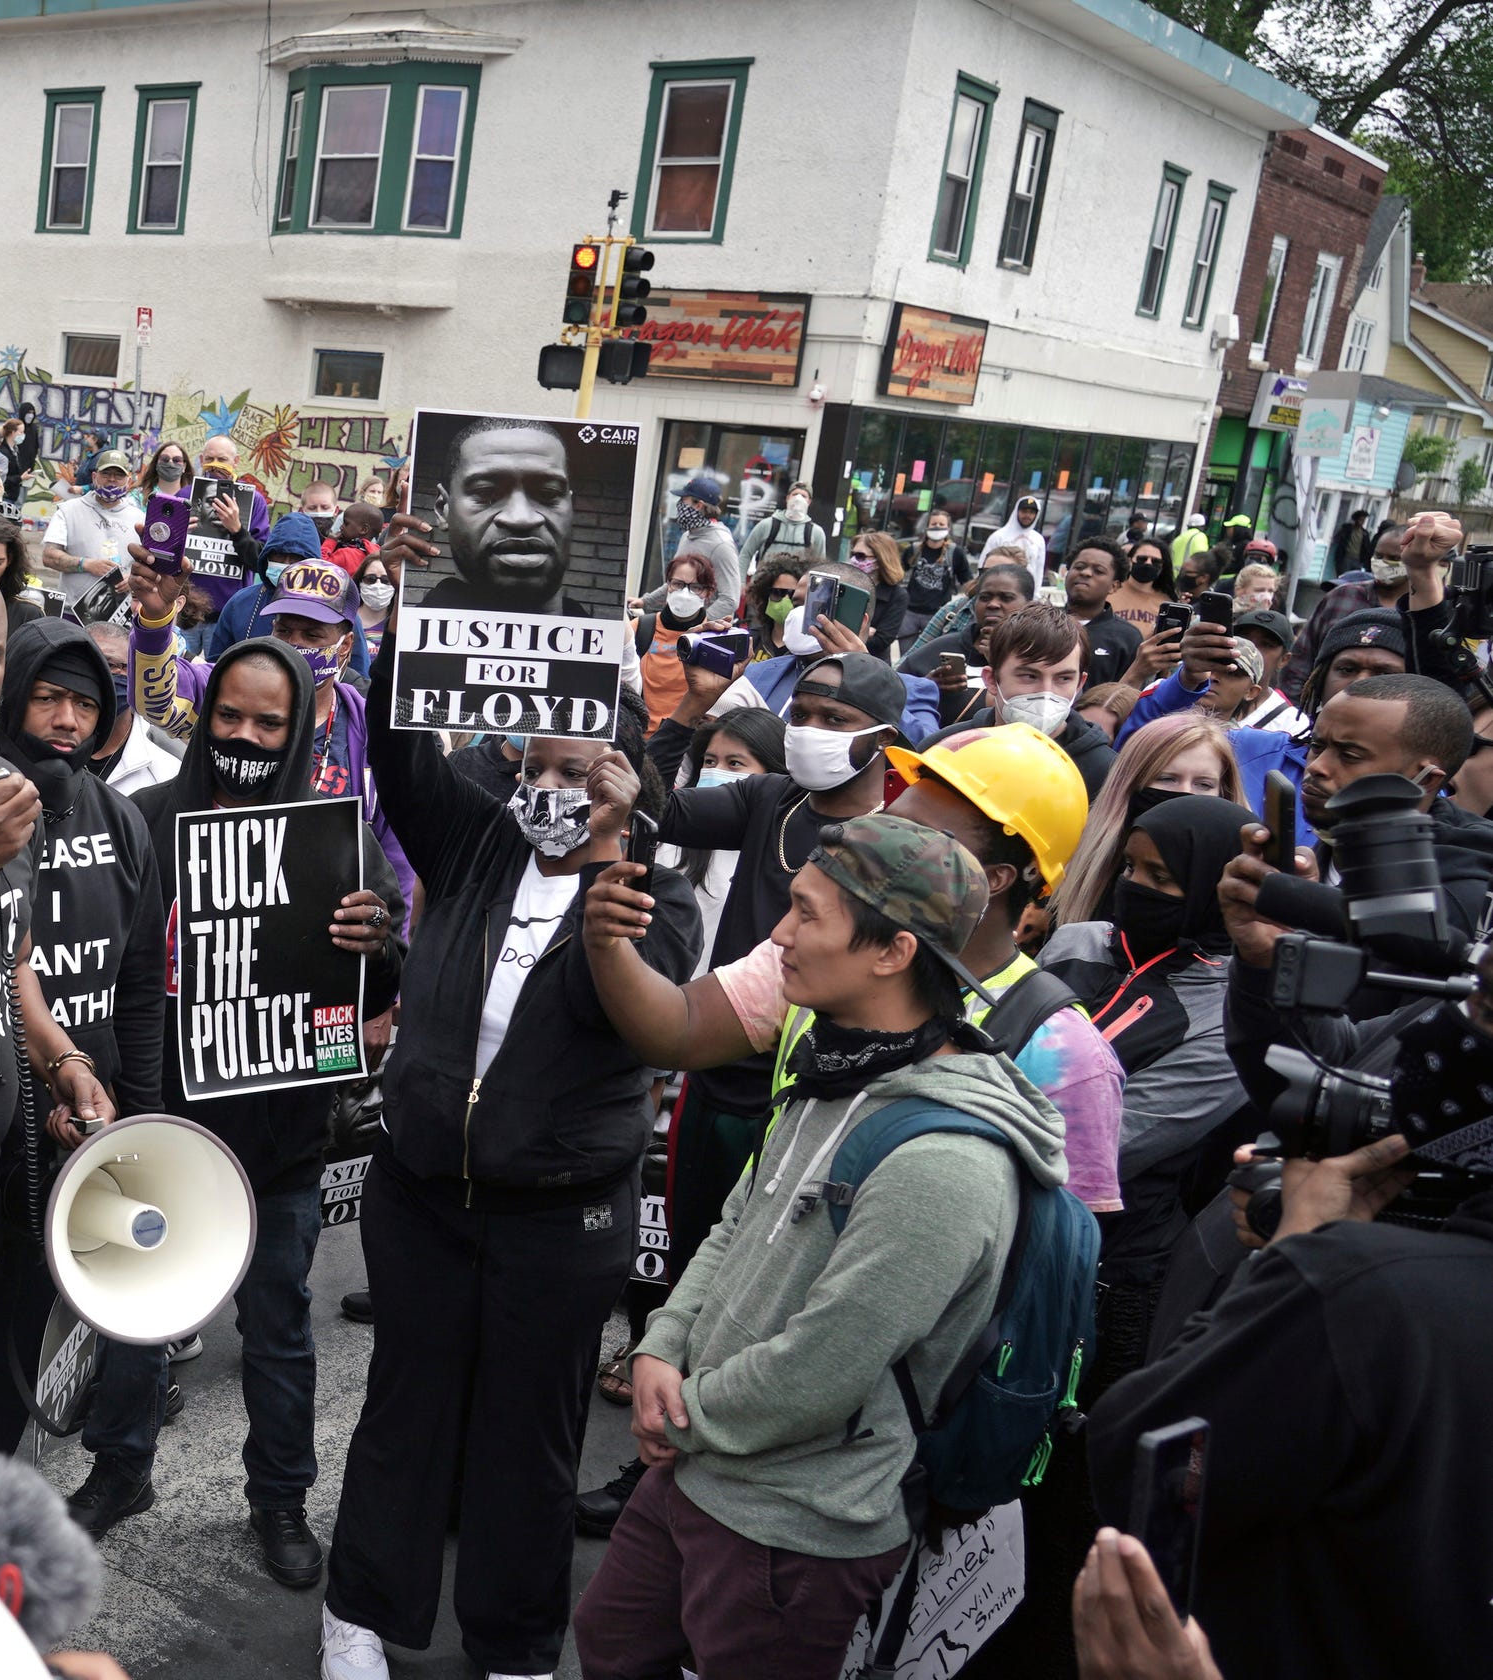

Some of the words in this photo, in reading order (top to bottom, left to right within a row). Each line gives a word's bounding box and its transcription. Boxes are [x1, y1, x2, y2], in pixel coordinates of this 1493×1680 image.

[719, 309, 804, 353] Wok
[892, 329, 948, 396] Dragon
[948, 333, 986, 375] Wok
[600, 427, 637, 443] CAIR
[415, 618, 604, 656] JUSTICE
[478, 663, 537, 684] FOR
[409, 688, 609, 733] FLOYD
[188, 816, 291, 912] FUCK
[52, 891, 61, 922] I
[189, 916, 261, 1003] THE
[314, 1005, 354, 1027] BLACK
[190, 991, 314, 1083] POLICE
[315, 1024, 354, 1046] LIVES
[316, 1044, 356, 1061] MATTER
[317, 1059, 334, 1067] NEW
[337, 1056, 357, 1065] YORK
[331, 1185, 360, 1200] FOR
[975, 1586, 1017, 1632] Smith
